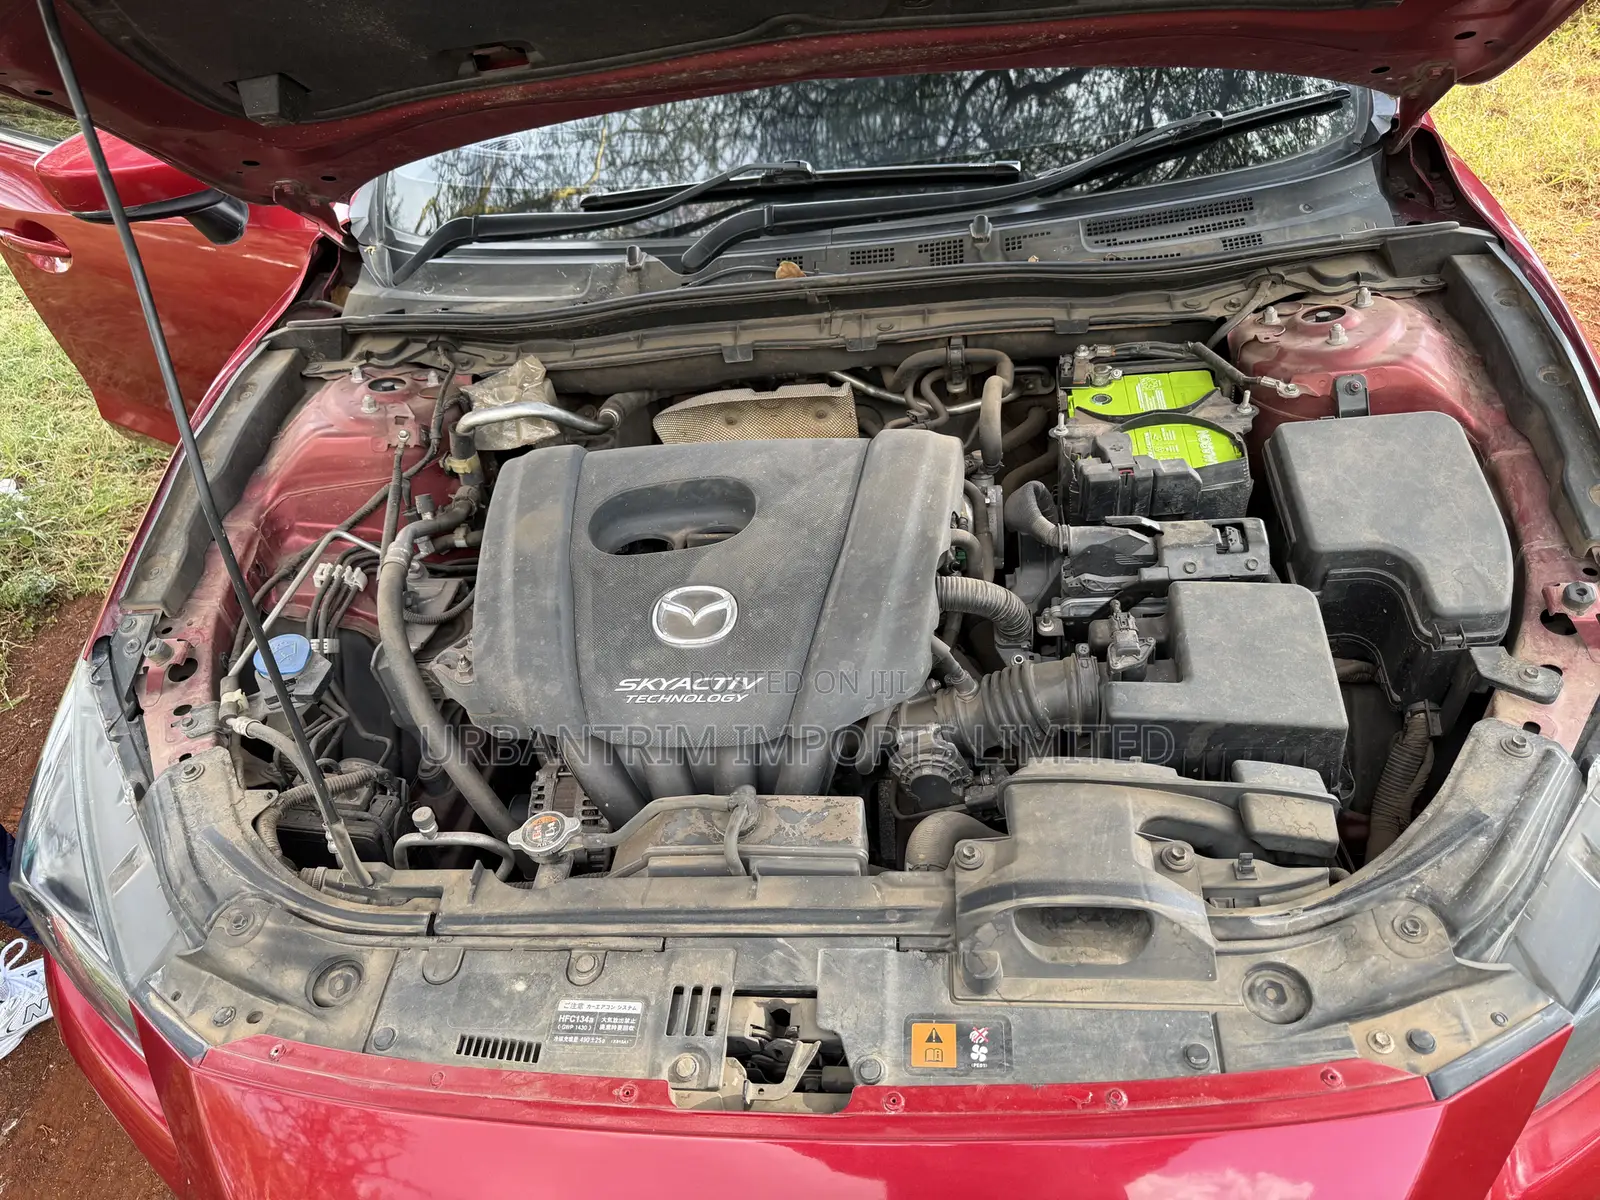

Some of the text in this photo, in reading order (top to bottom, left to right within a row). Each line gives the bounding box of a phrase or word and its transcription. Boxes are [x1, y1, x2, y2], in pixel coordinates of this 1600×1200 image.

[614, 677, 765, 692] SKYACTIV
[625, 693, 749, 704] TECHNOLOGY
[558, 1014, 594, 1023] HFC134a
